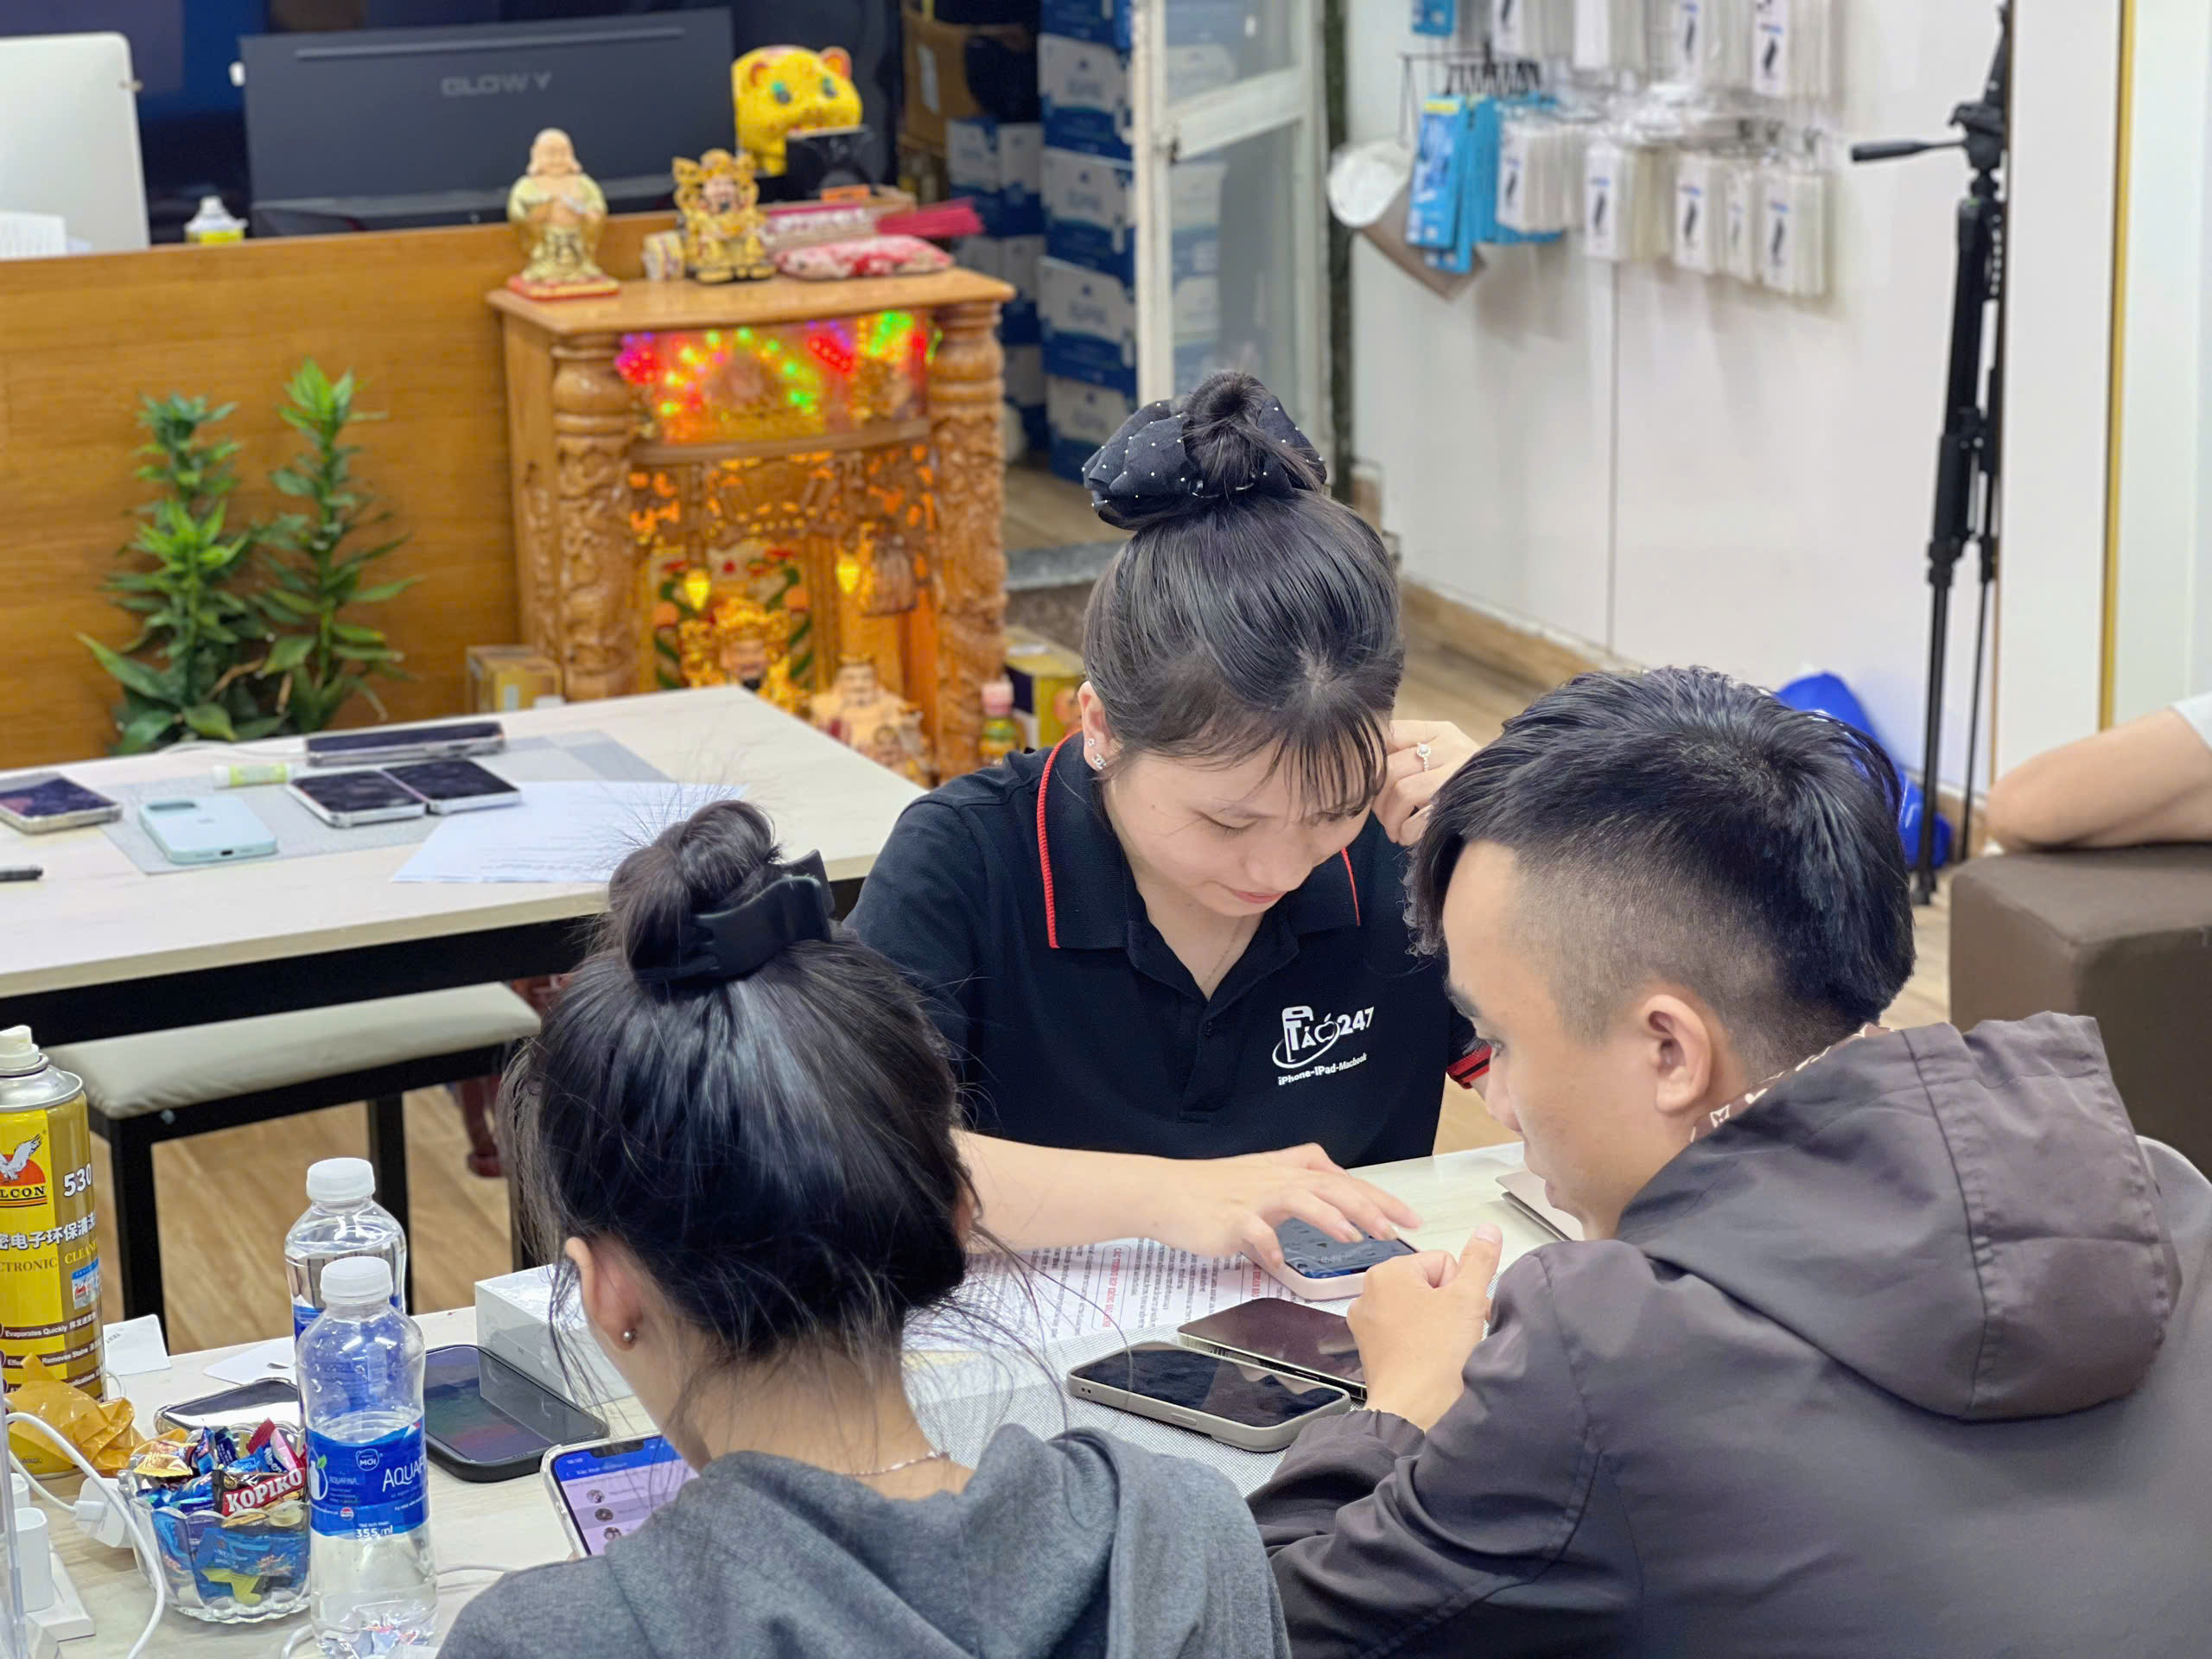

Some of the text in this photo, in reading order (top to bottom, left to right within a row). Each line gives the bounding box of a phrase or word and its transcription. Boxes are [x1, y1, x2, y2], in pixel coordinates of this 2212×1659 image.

[63, 1162, 92, 1198] 530
[0, 1257, 57, 1272] TRONIC
[43, 1324, 68, 1336] Quickly
[225, 1469, 303, 1513] KOPIKO
[355, 1524, 393, 1538] 355 ml
